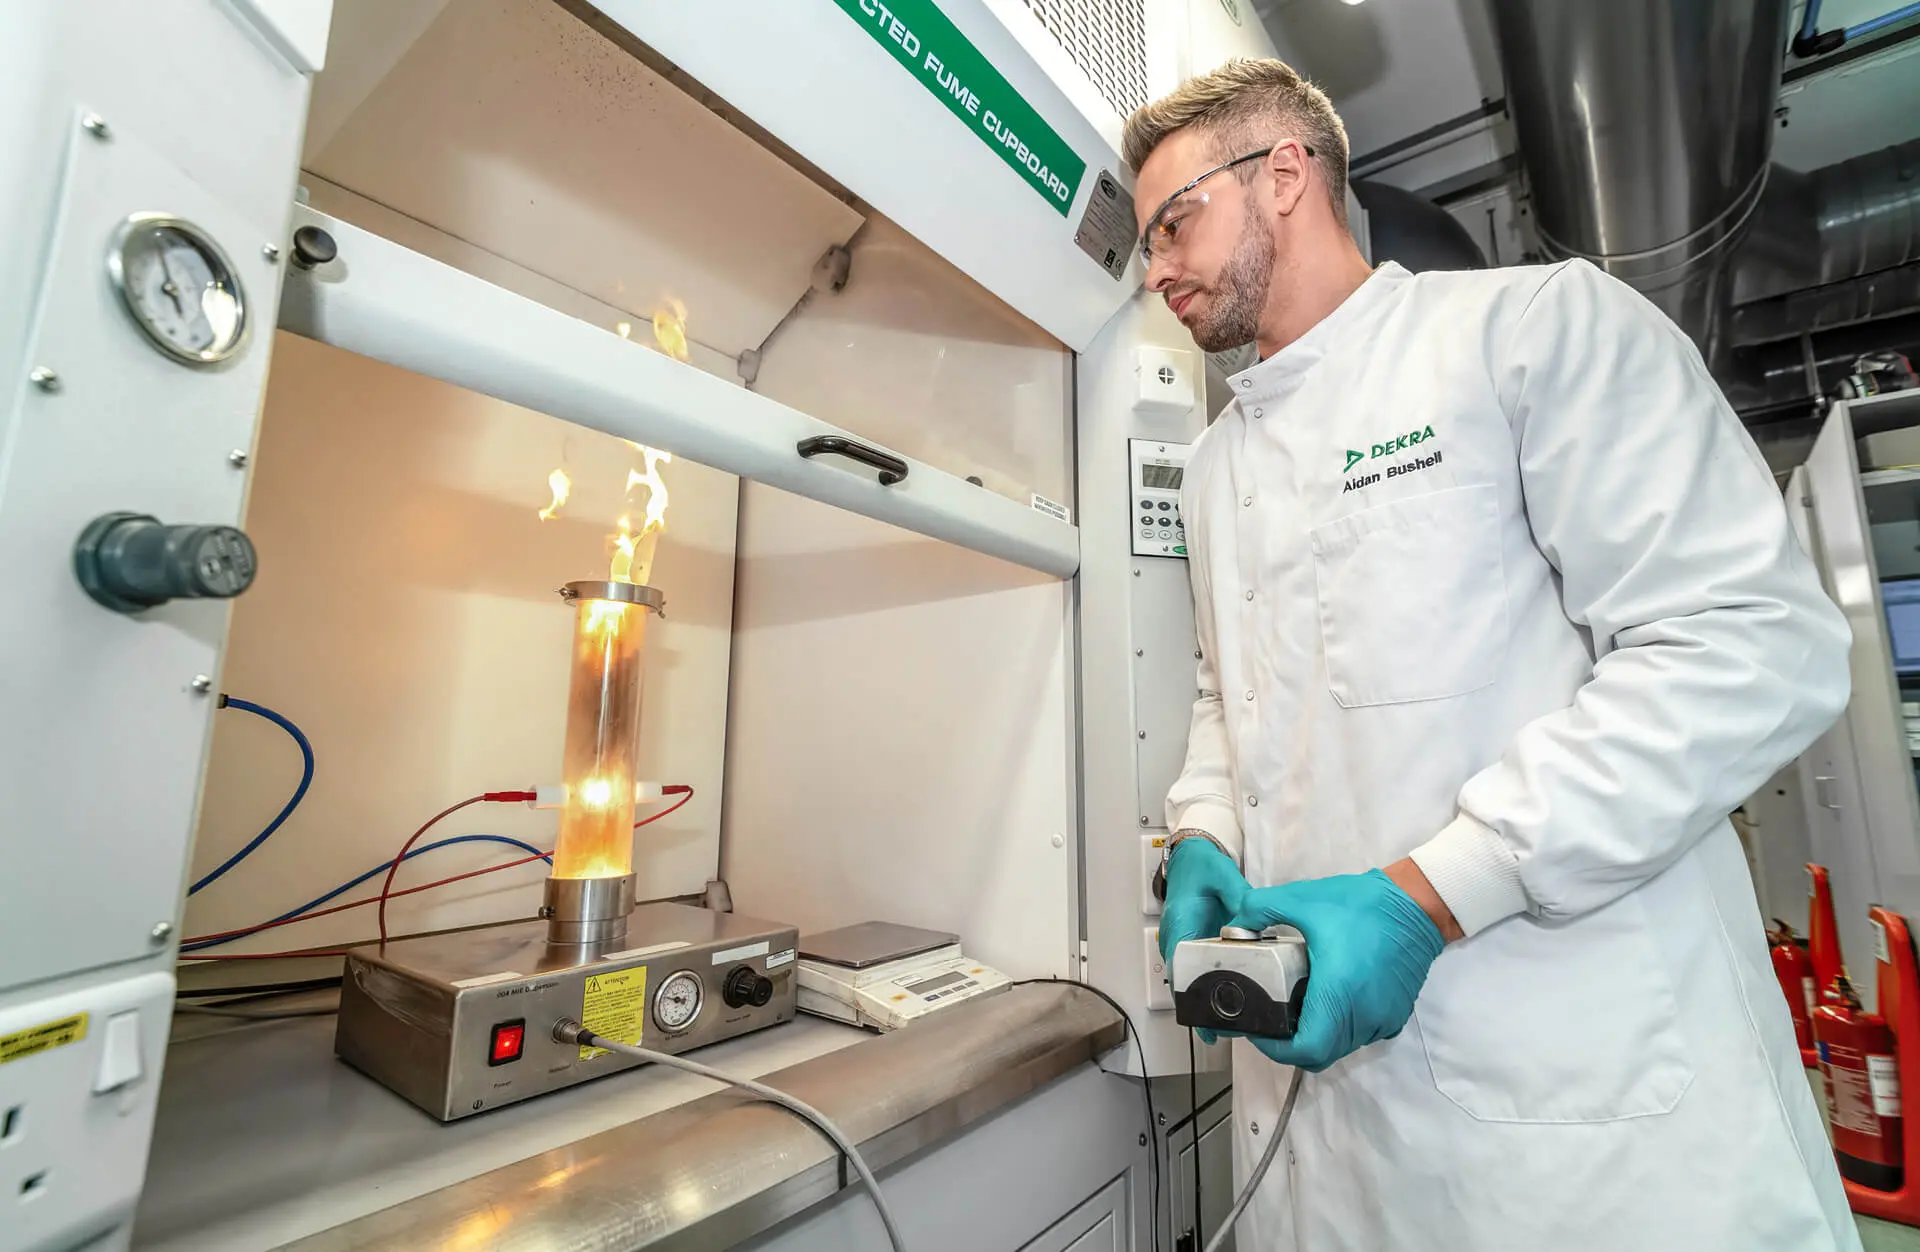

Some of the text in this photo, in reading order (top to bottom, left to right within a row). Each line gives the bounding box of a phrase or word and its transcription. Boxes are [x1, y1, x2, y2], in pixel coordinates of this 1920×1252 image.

[923, 51, 981, 117] FUME
[982, 109, 1070, 202] CUPBOARD
[1370, 424, 1436, 459] DEKRA
[1343, 450, 1443, 494] Aidan Bushell
